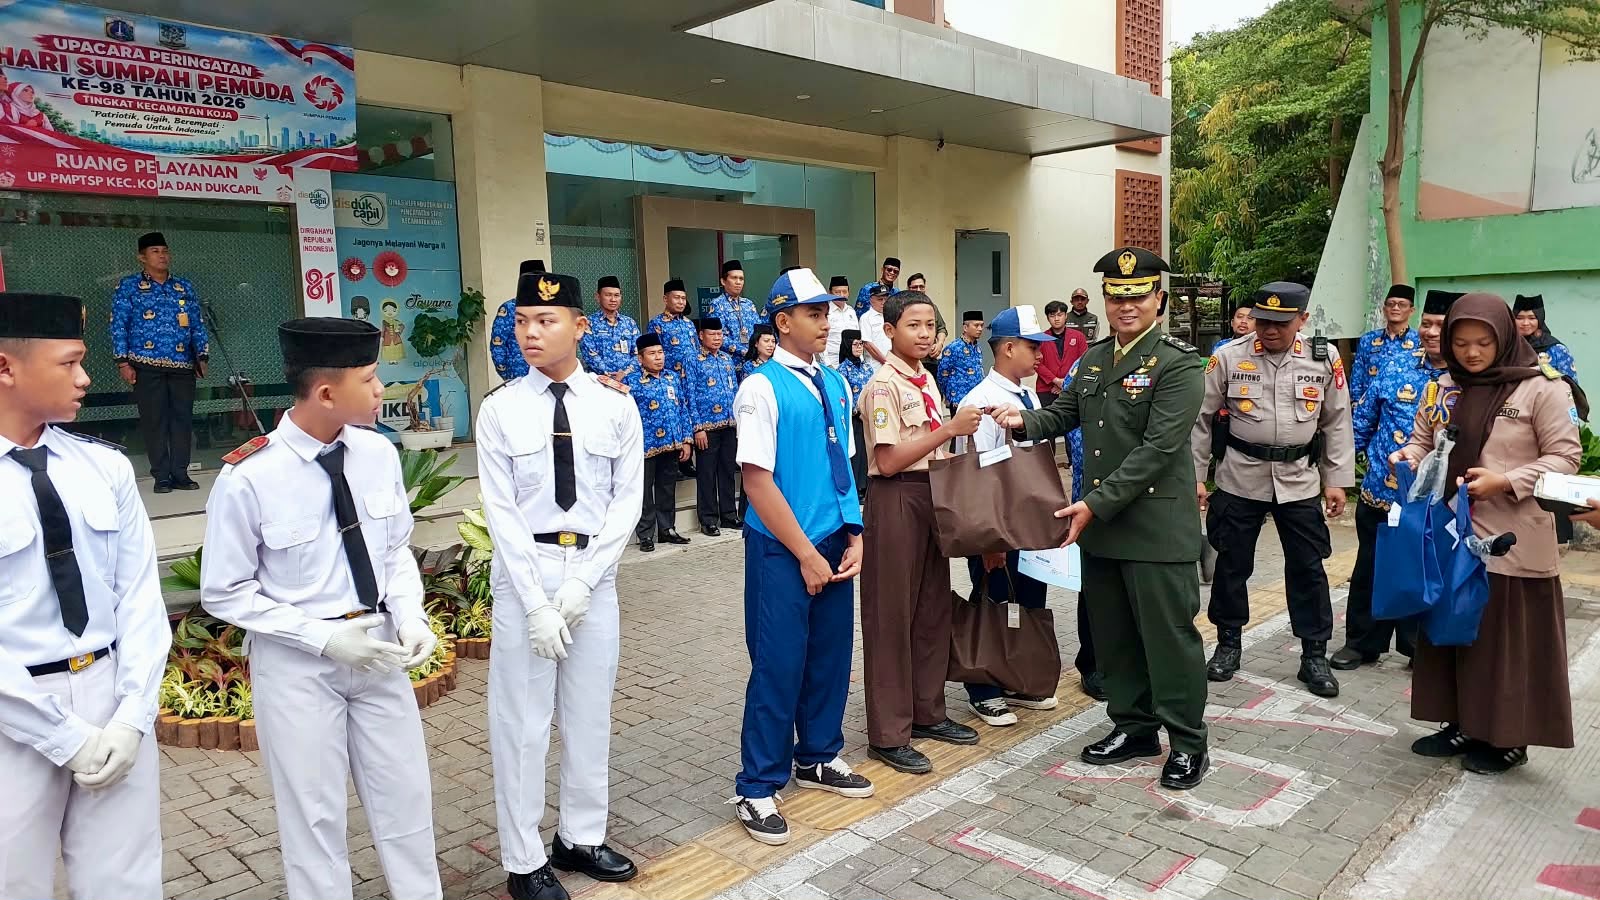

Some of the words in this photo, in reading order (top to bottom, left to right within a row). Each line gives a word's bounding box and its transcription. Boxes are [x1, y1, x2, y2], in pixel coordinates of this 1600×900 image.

[54, 38, 145, 60] UPACARA
[150, 52, 252, 76] PERINGATAN
[0, 47, 69, 73] HARI
[76, 57, 191, 88] SUMPAH
[198, 73, 296, 103] PEMUDA
[62, 77, 125, 95] KE-98
[131, 86, 196, 103] TAHUN
[202, 94, 246, 109] 2026
[83, 95, 134, 108] TINGKAT
[137, 102, 204, 115] KECAMATAN
[207, 110, 232, 119] KOJA
[105, 120, 142, 129] Pemuda
[146, 123, 173, 131] Untuk
[56, 153, 128, 172] RUANG
[135, 160, 238, 179] PELAYANAN
[28, 171, 47, 183] UP
[51, 173, 104, 187] PMPTSP
[177, 182, 203, 192] DAN
[206, 183, 262, 195] DUKCAPIL
[353, 207, 380, 221] capil
[300, 227, 334, 235] DIRGAHAYU
[303, 236, 332, 244] REPUBLIK
[303, 245, 335, 253] INDONESIA
[352, 238, 384, 248] Jagonya
[385, 239, 417, 249] Melayani
[418, 241, 440, 250] Warga
[305, 268, 336, 305] 81
[1297, 375, 1325, 383] POLRI
